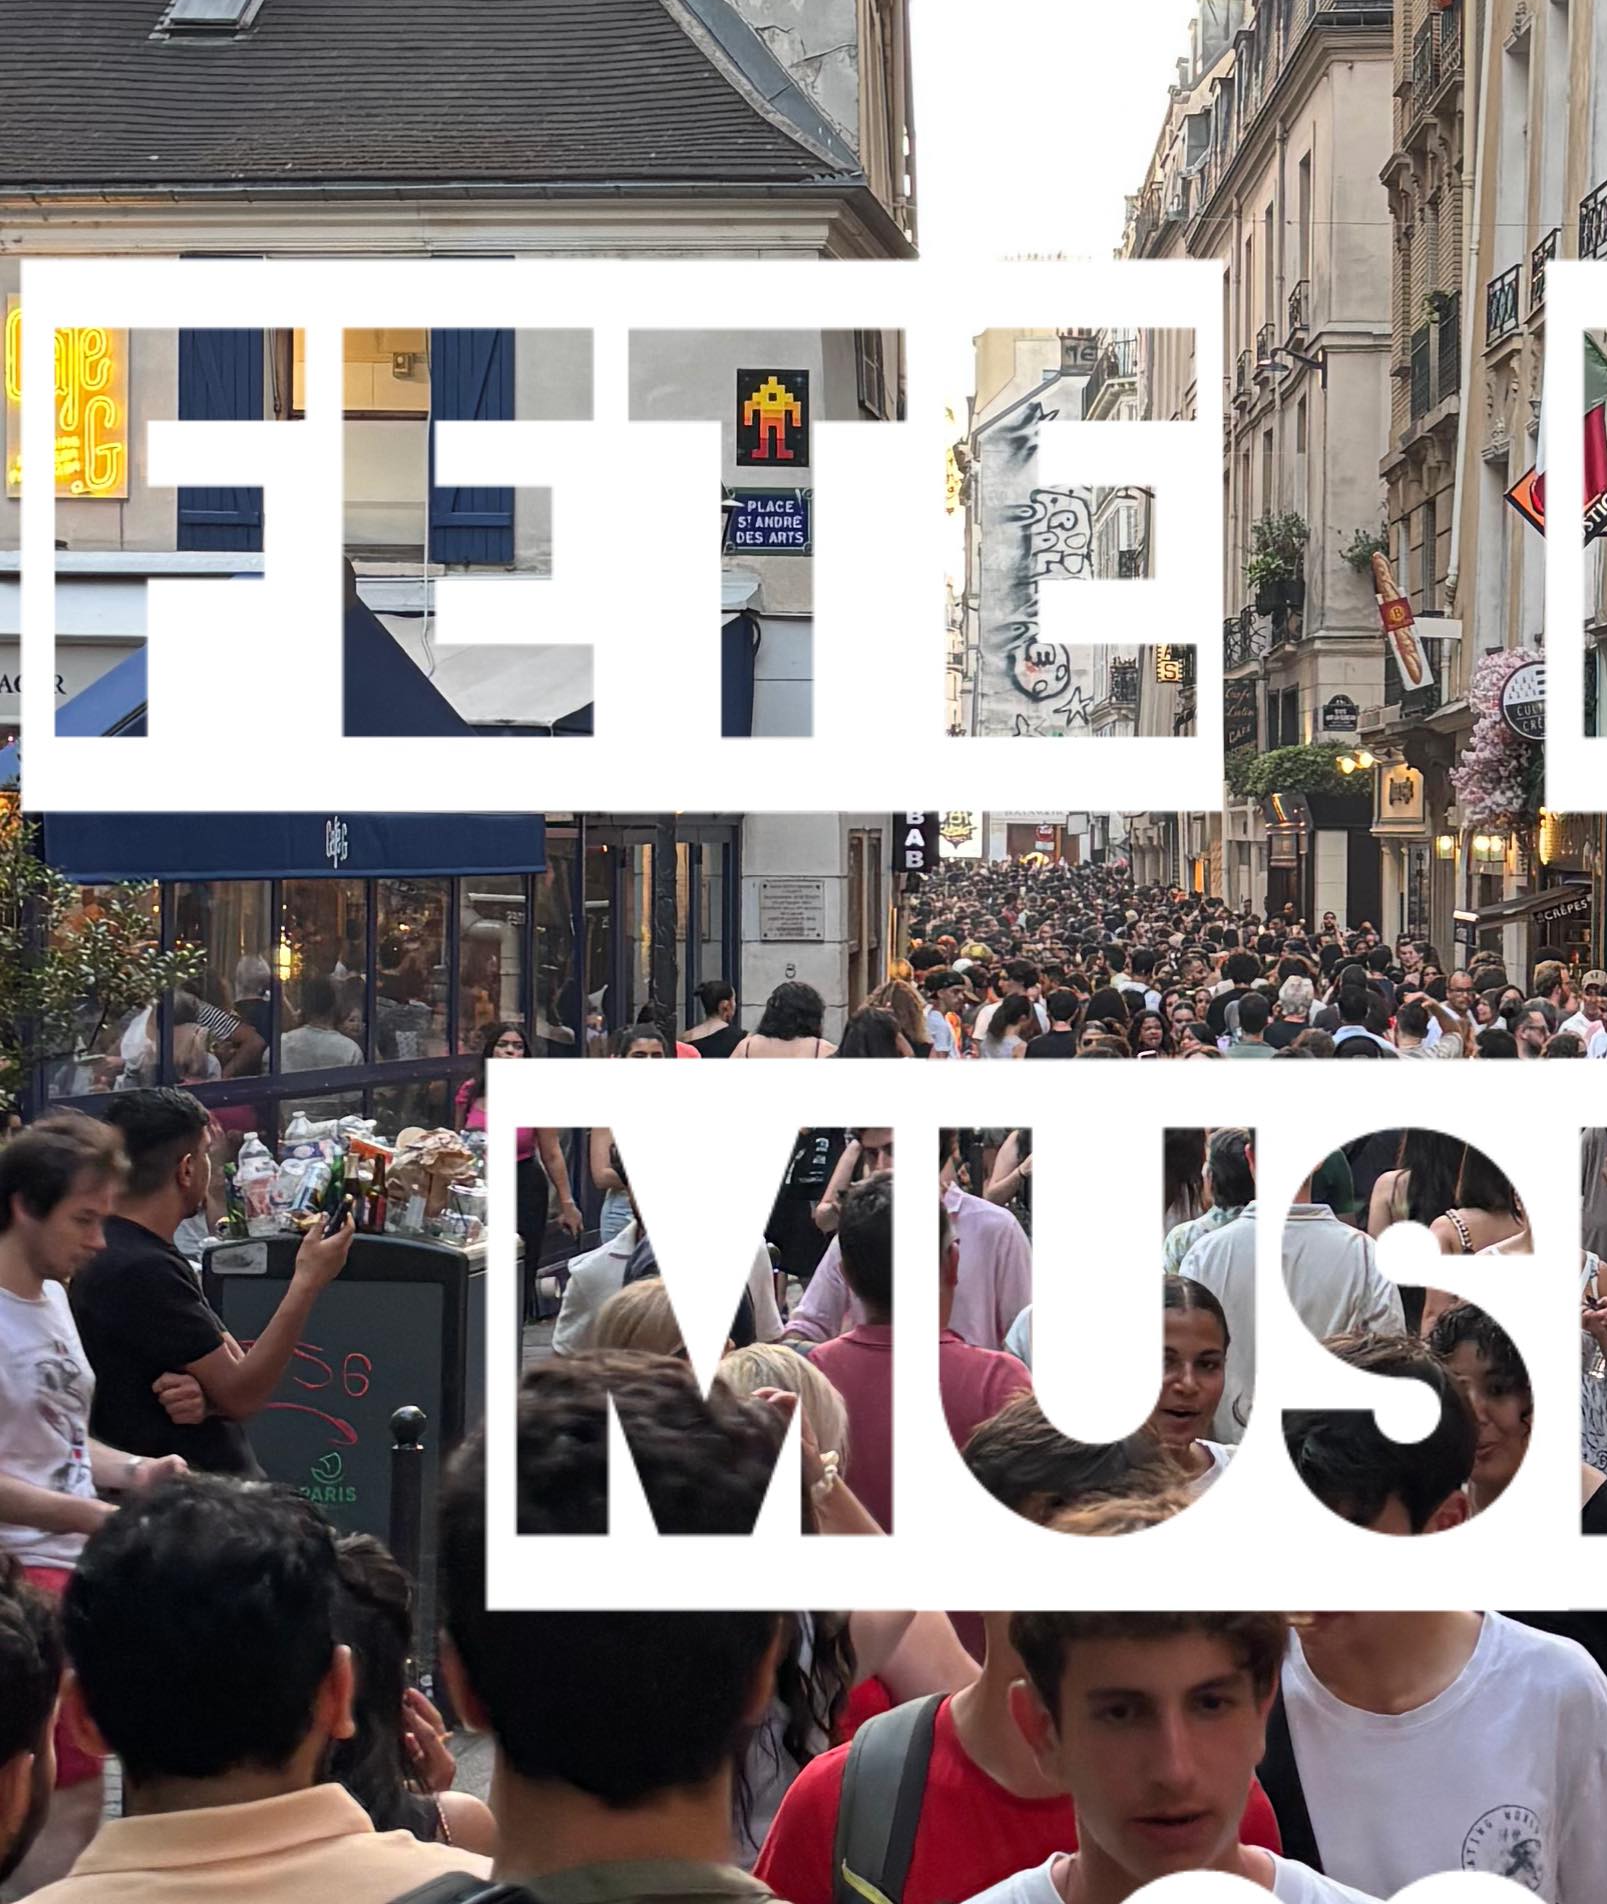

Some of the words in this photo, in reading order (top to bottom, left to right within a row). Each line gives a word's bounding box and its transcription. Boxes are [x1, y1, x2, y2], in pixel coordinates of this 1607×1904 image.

[747, 500, 795, 513] PLACE
[736, 531, 764, 544] DES
[768, 531, 804, 544] ARTS
